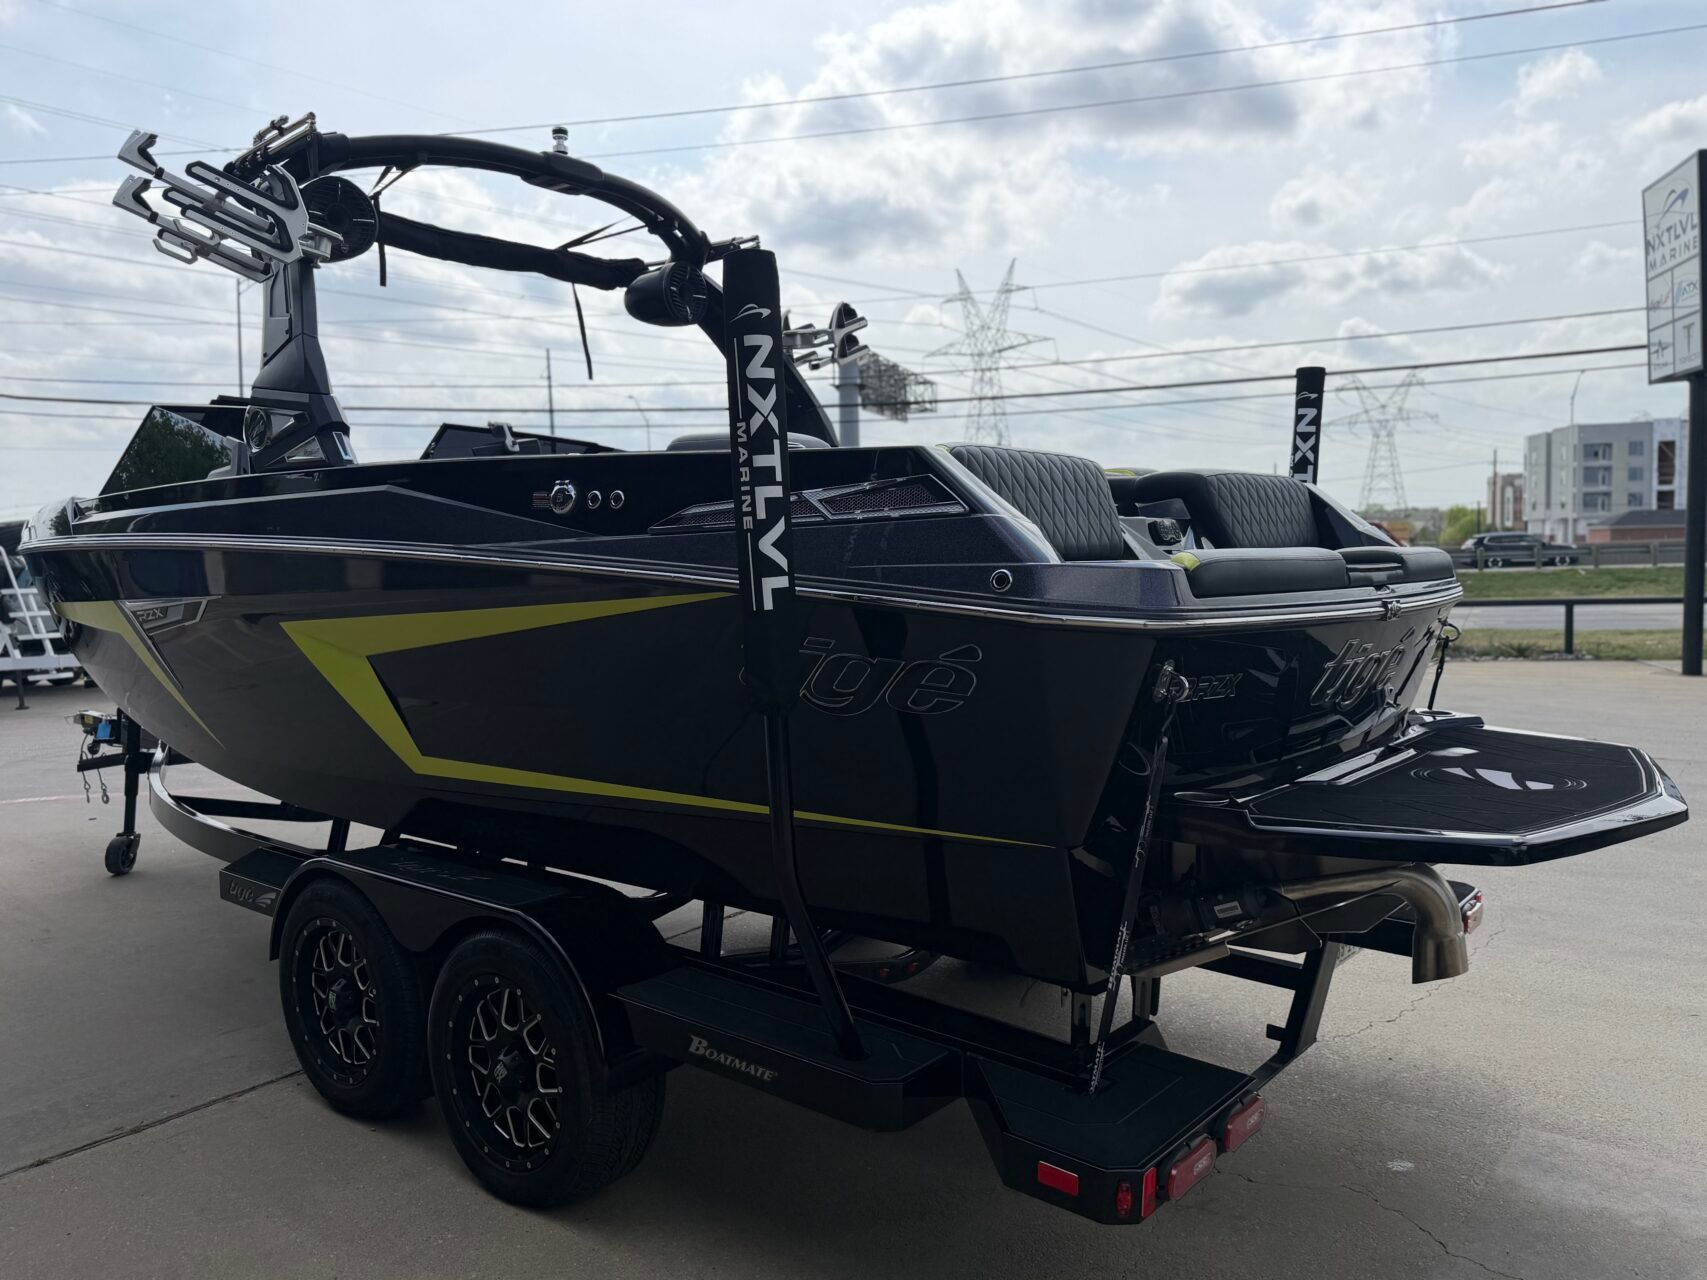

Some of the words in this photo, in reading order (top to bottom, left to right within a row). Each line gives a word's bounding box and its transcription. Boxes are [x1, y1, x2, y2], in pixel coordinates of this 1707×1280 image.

[1647, 212, 1698, 257] NXTLVL
[1648, 235, 1699, 273] MARINE
[736, 421, 754, 530] MARINE
[743, 334, 789, 611] NXTLVL
[738, 635, 982, 716] igé
